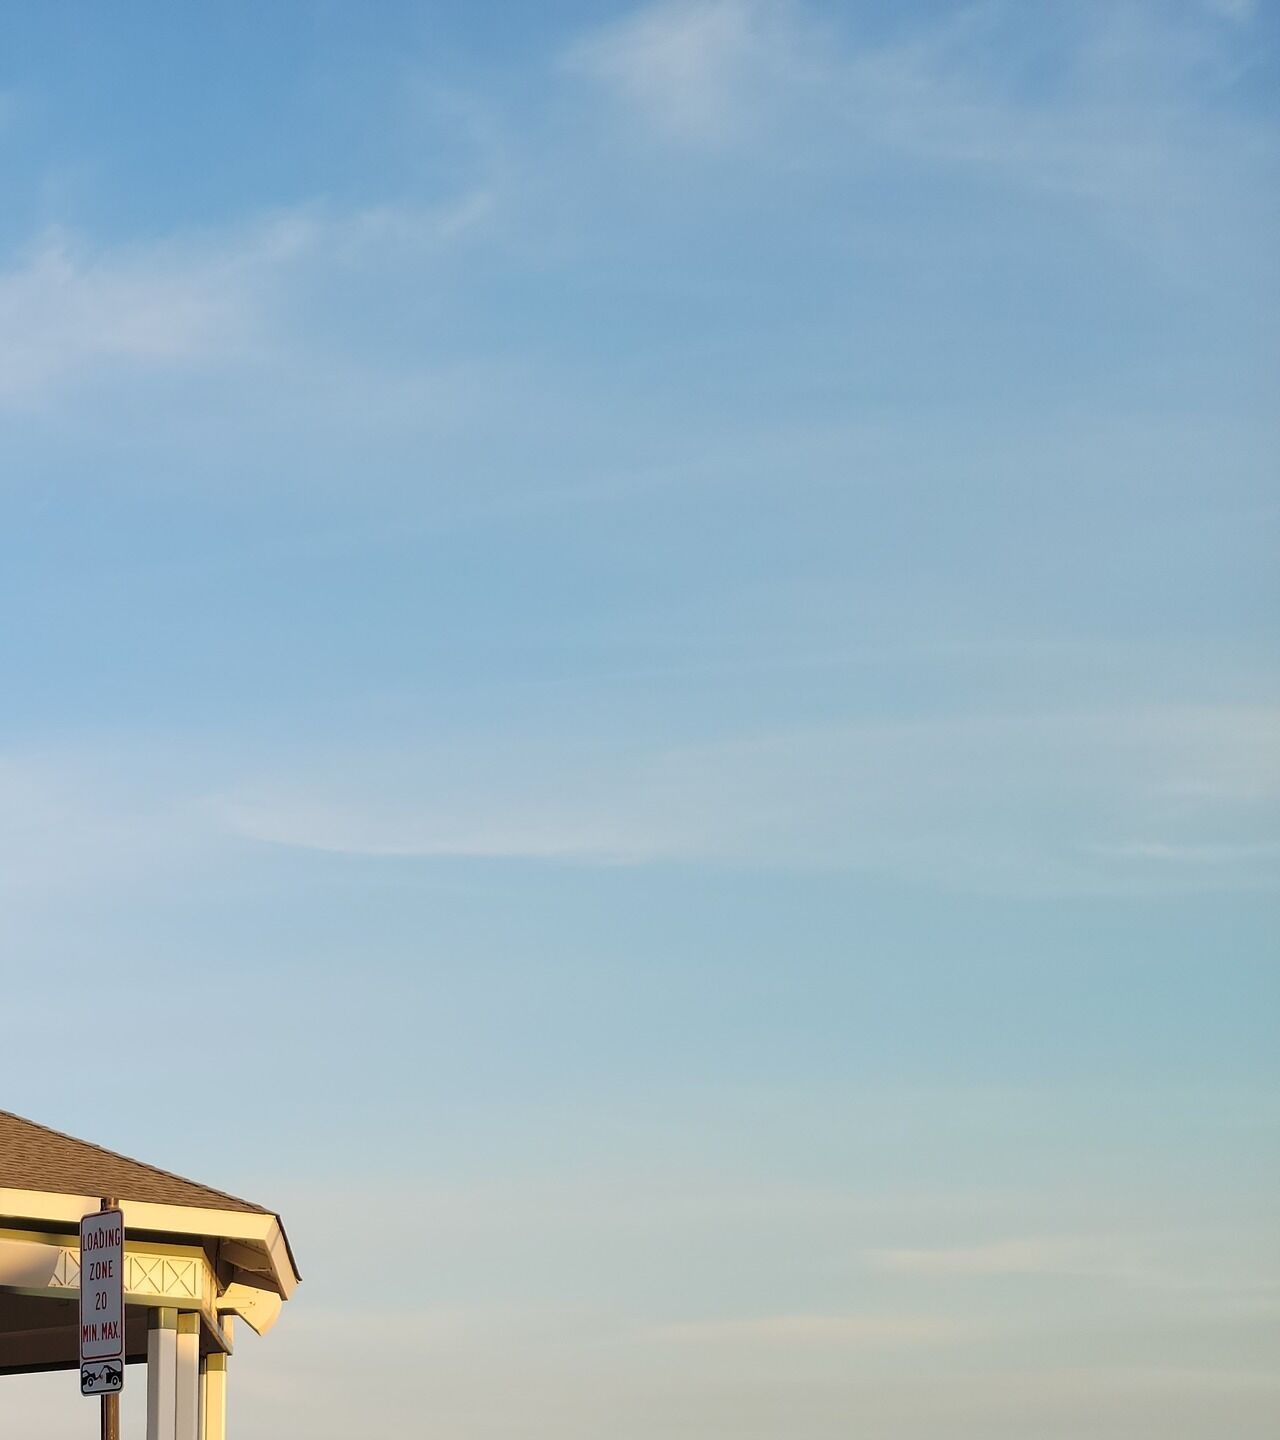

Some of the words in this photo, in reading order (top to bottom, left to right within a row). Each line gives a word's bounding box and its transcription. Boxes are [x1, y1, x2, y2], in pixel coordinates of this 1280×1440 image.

[83, 1228, 121, 1252] LOADING
[90, 1260, 113, 1281] ZONE
[95, 1292, 107, 1311] 20
[83, 1323, 100, 1343] MIN.
[101, 1321, 121, 1340] MAX.
